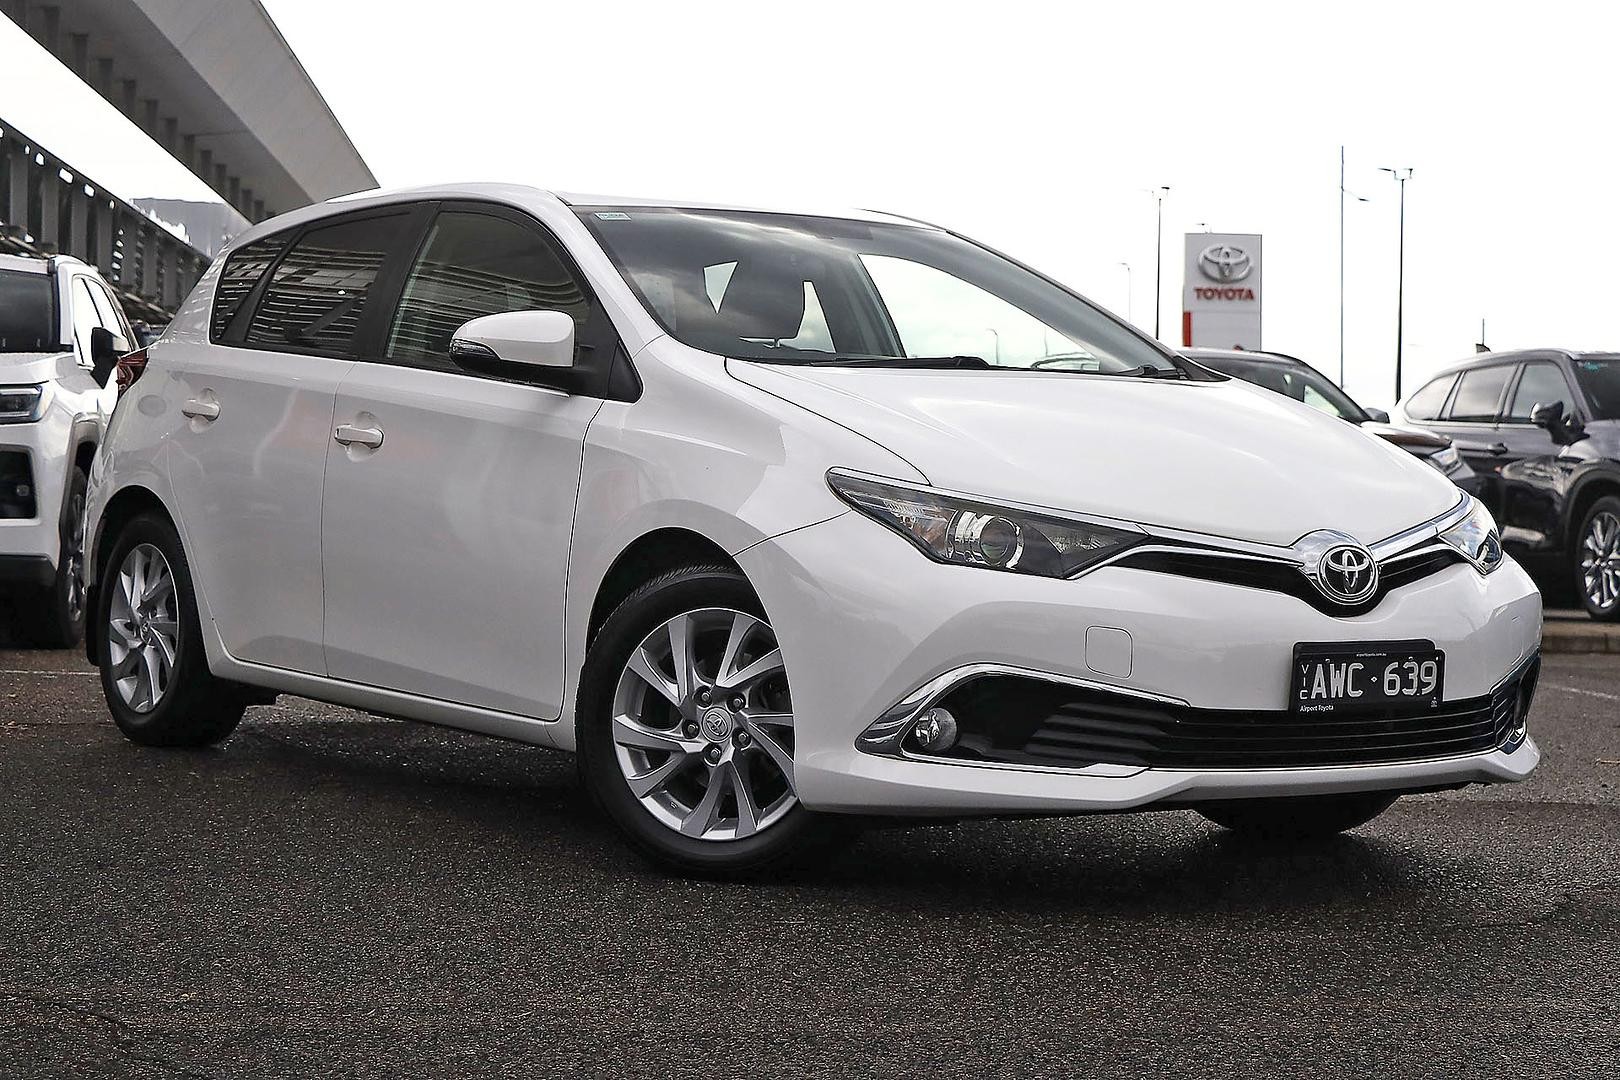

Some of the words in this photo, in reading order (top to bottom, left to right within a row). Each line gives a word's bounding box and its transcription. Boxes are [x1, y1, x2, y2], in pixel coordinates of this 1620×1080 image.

[1194, 287, 1254, 300] TOYOTA
[1311, 663, 1364, 698] AWC
[1384, 661, 1437, 696] 639
